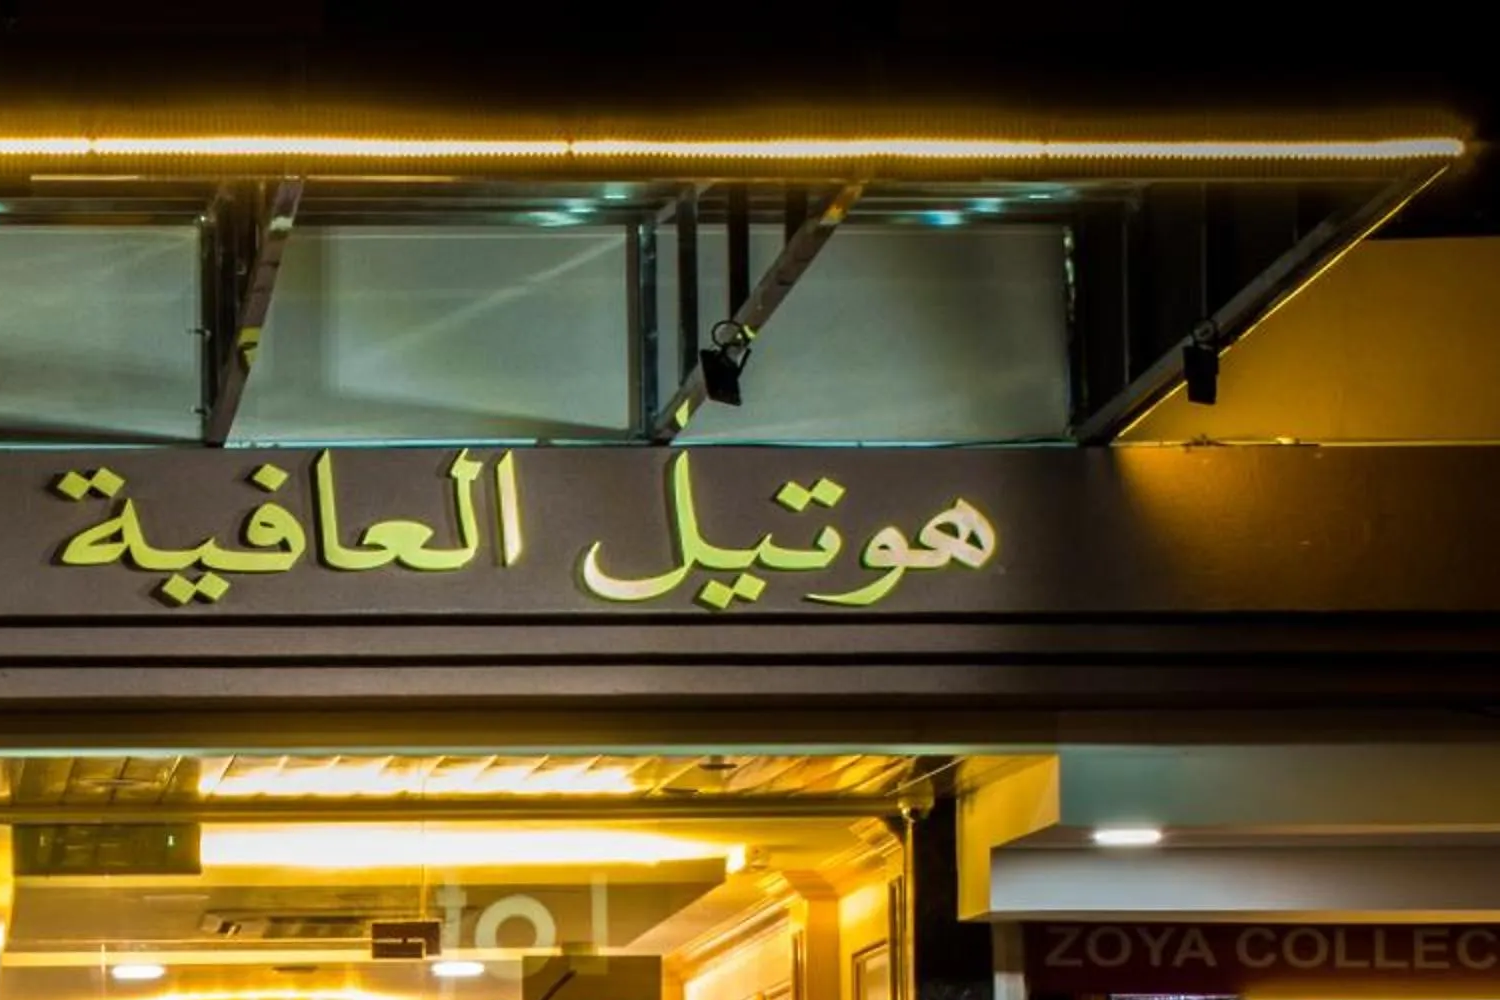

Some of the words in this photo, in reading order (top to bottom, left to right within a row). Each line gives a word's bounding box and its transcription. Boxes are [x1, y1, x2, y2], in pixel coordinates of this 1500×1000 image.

[56, 447, 523, 606] العافية
[581, 449, 998, 608] هوتيل
[1043, 925, 1218, 968] ZOYA
